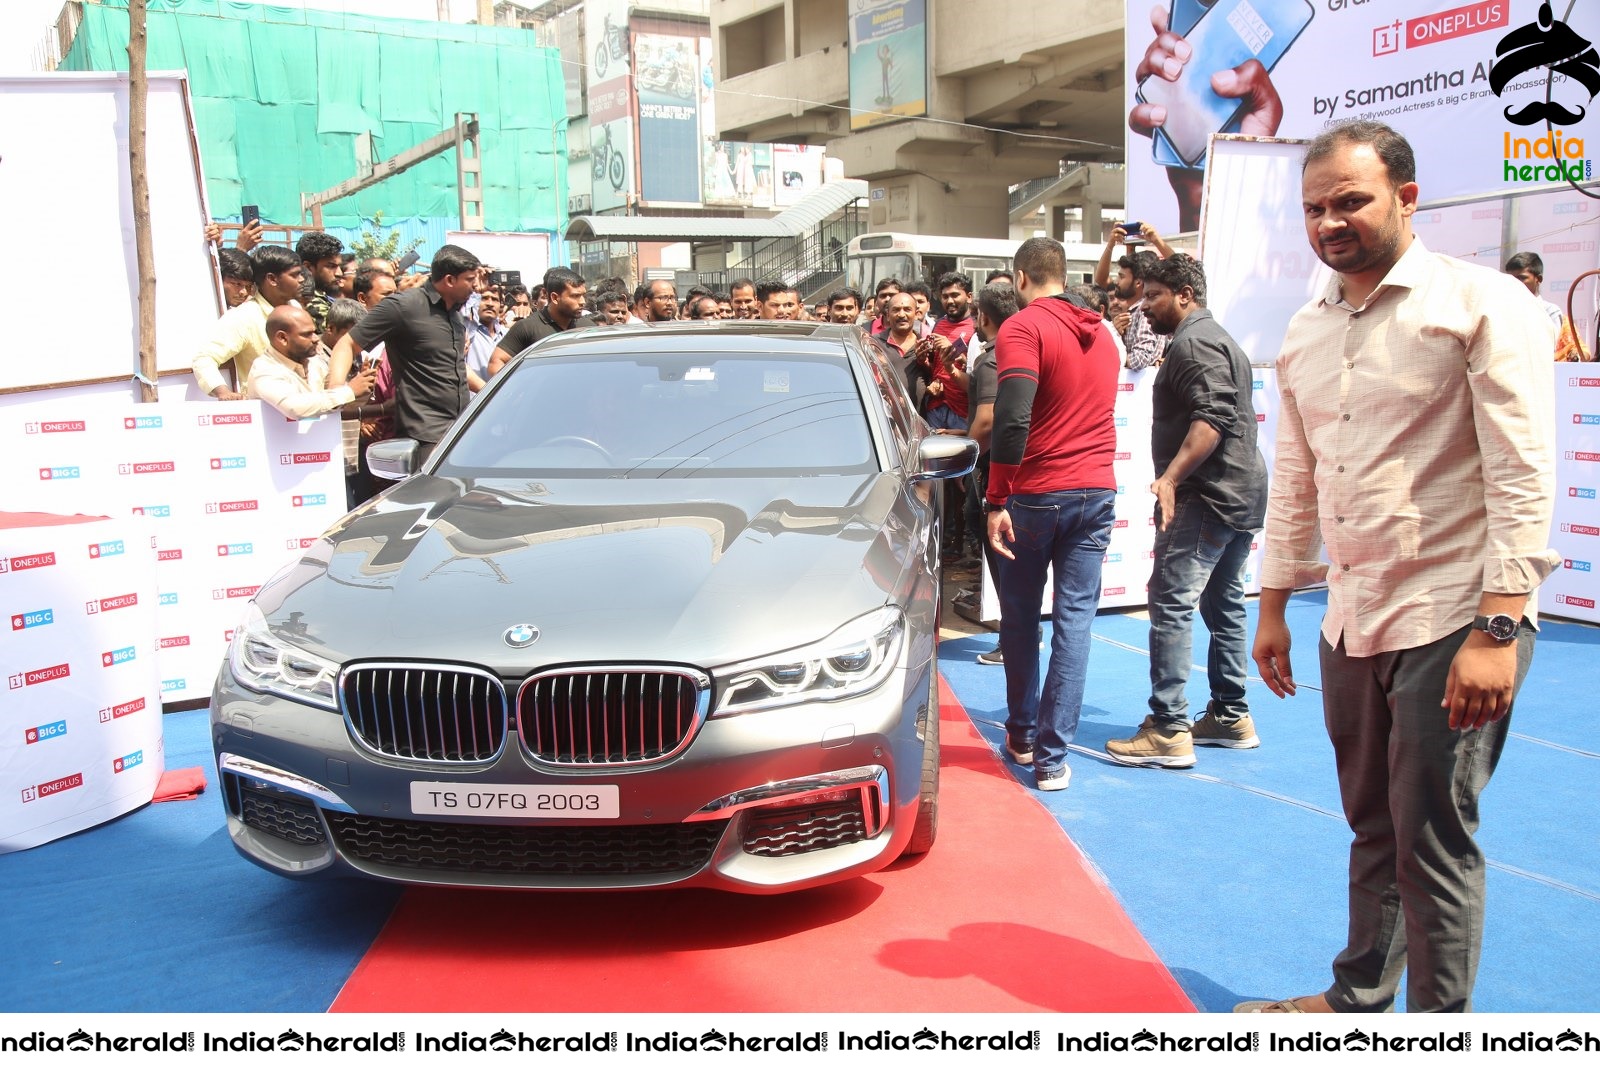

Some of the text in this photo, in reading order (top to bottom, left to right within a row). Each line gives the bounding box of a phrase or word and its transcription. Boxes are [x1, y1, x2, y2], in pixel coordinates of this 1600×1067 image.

[1413, 5, 1501, 40] ONEPLUS
[1314, 70, 1464, 118] by Samantha
[1360, 106, 1401, 120] Tollywood
[1403, 101, 1435, 112] Actress
[1446, 95, 1459, 105] Big
[136, 417, 161, 426] BIG C
[215, 415, 249, 423] ONEPLUS
[44, 423, 83, 431] ONEPLUS
[222, 458, 245, 467] BIG C
[296, 454, 329, 462] ONEPLUS
[52, 468, 78, 477] BIG C
[1577, 489, 1589, 497] BIG
[162, 507, 168, 515] C
[221, 502, 256, 510] ONEPLUS
[1572, 525, 1598, 534] ONEPLUS
[100, 541, 123, 554] BIG C
[228, 544, 251, 553] BIG C
[14, 555, 53, 568] ONEPLUS
[229, 587, 258, 596] ONEPLU
[103, 596, 136, 608] ONEPLUS
[170, 594, 177, 602] C
[1567, 597, 1593, 607] ONEPLUS
[25, 612, 52, 625] BIG C
[113, 649, 135, 661] BIG C
[28, 667, 67, 682] ONEPLUS
[178, 680, 185, 688] C
[115, 700, 144, 716] ONEPLUS
[39, 723, 65, 737] BIG C
[124, 753, 142, 767] BIG C
[41, 776, 80, 794] ONEPLUS
[428, 792, 600, 810] TS 07FQ 2003
